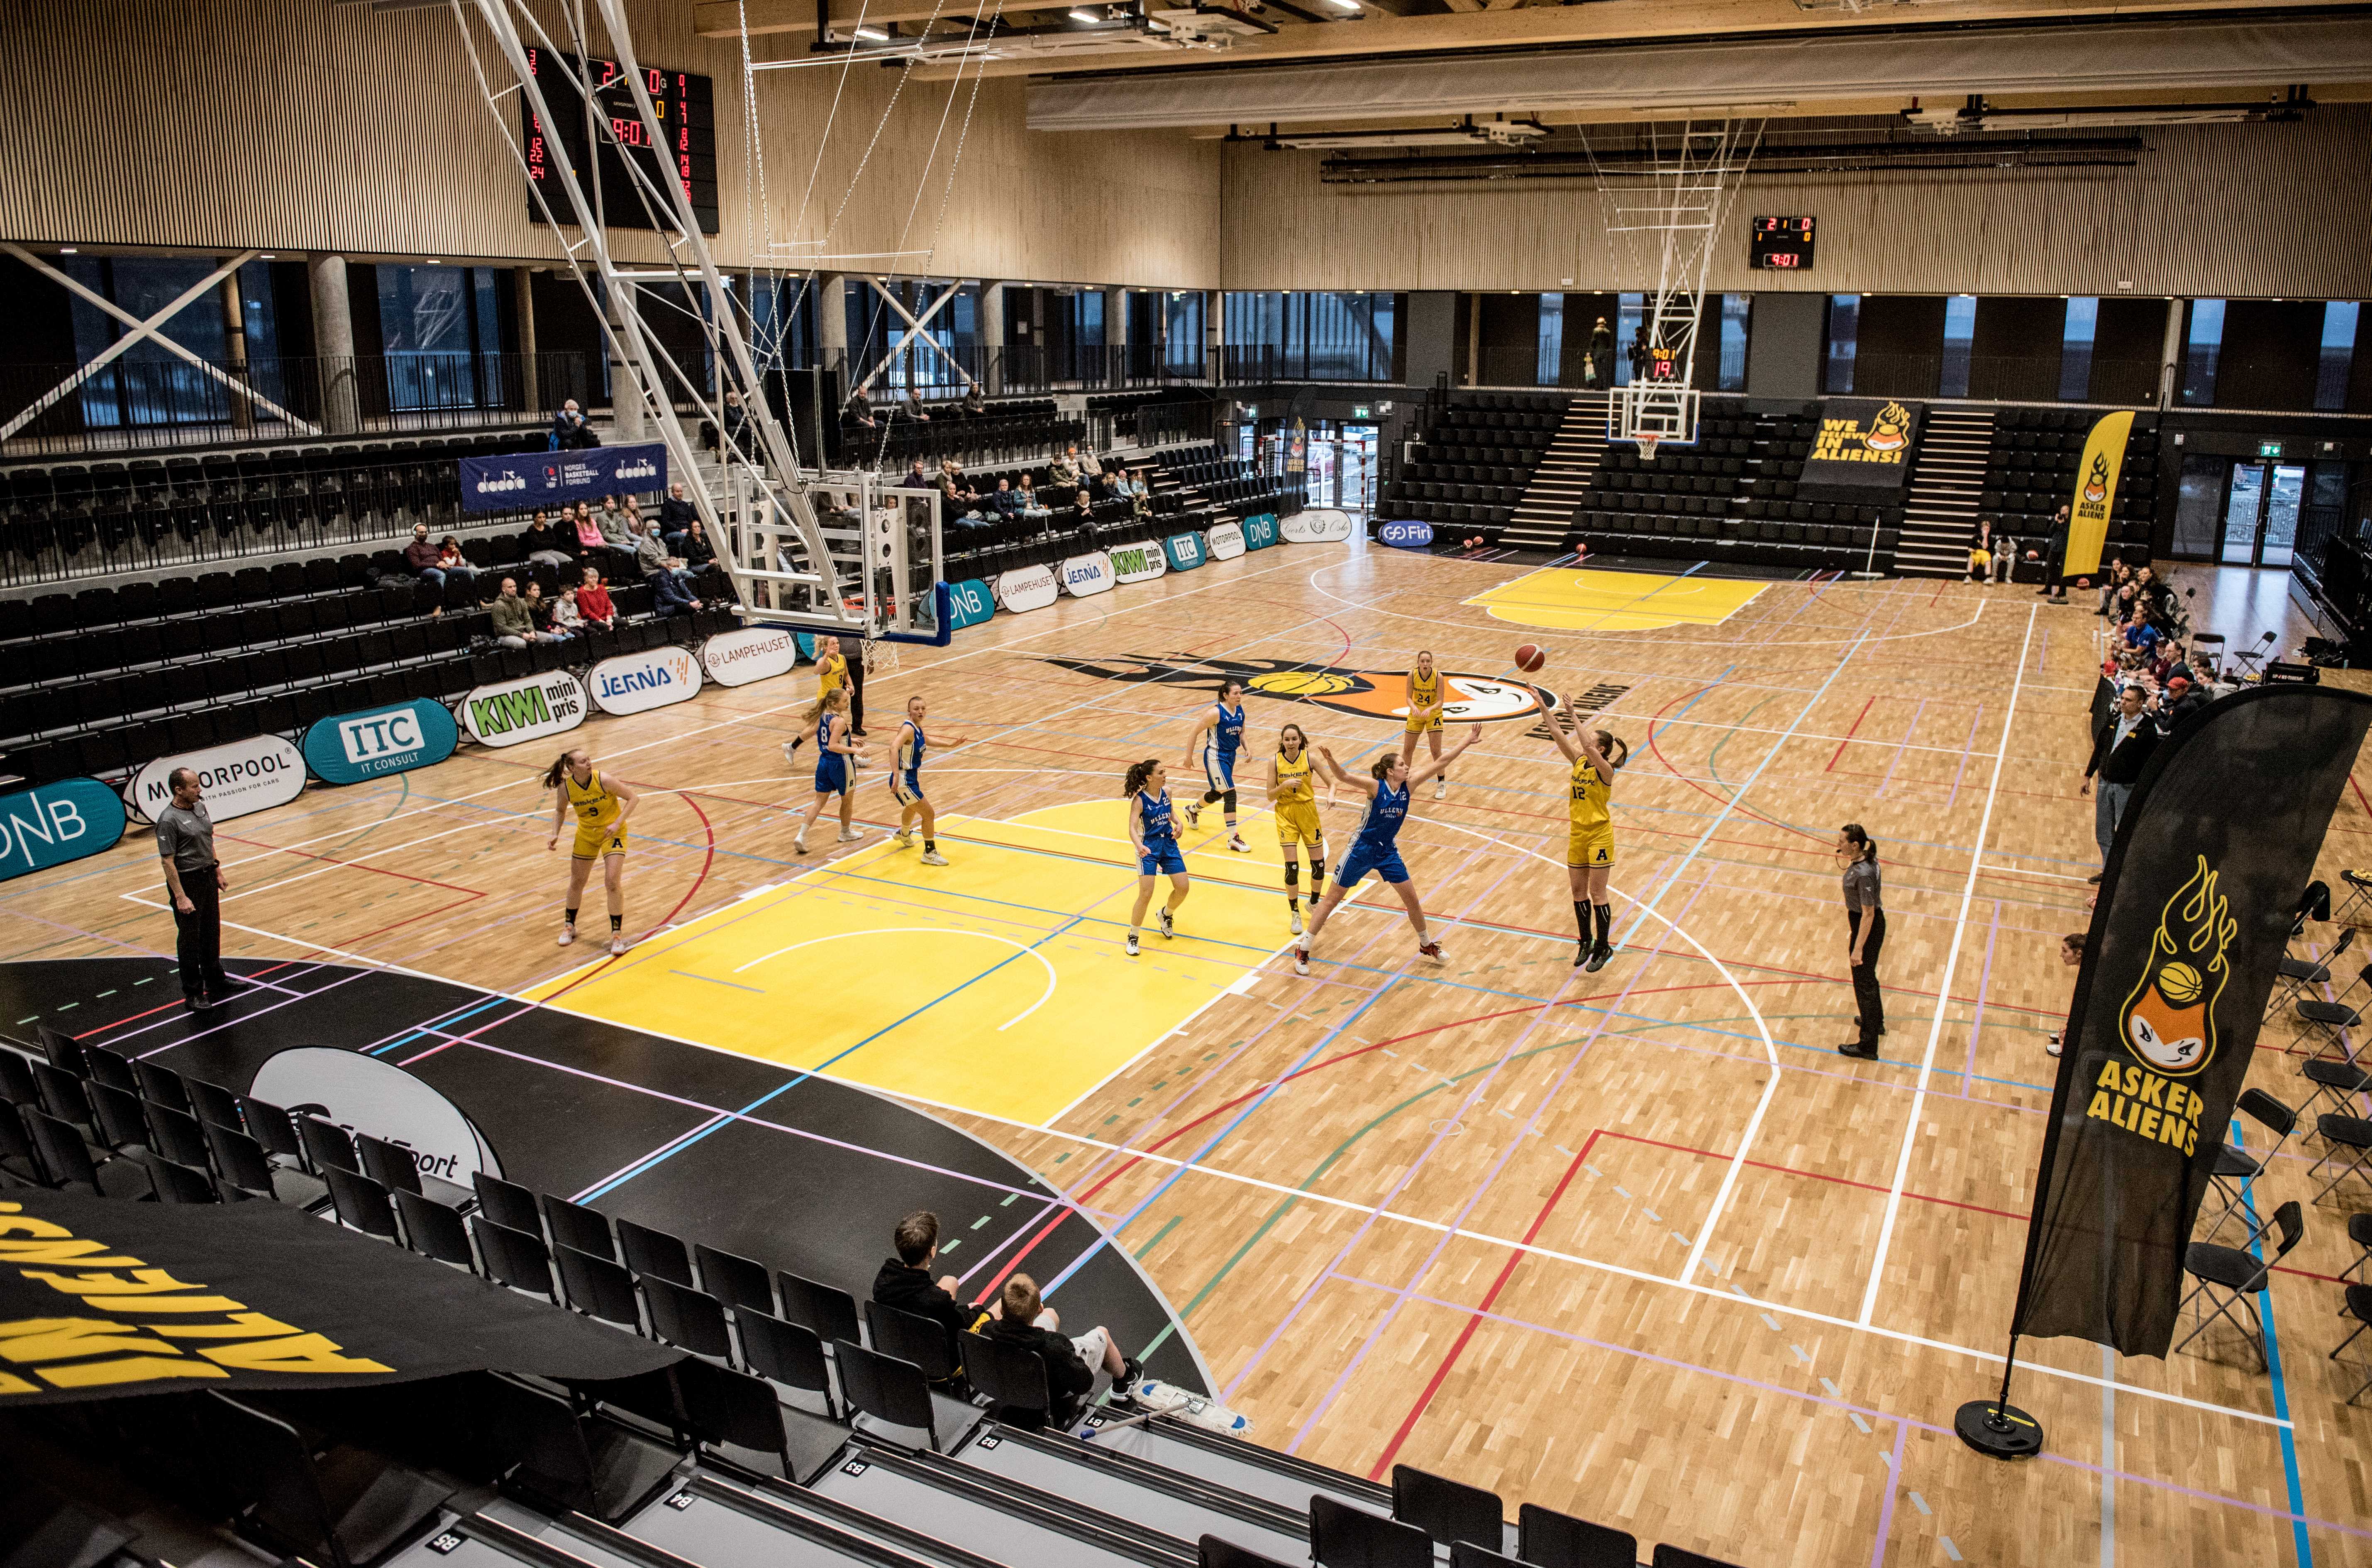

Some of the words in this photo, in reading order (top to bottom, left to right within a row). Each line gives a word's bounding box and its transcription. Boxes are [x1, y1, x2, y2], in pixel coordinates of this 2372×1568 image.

[603, 62, 613, 86] 2
[649, 69, 659, 93] 0
[679, 74, 685, 86] 0
[660, 78, 667, 89] G
[682, 87, 686, 97] 1
[656, 100, 664, 119] 0
[680, 101, 686, 112] 4
[681, 112, 687, 124] 7
[533, 137, 542, 150] 12
[530, 149, 543, 163] 22
[531, 166, 544, 179] 24
[1767, 217, 1777, 231] 2
[1783, 219, 1787, 229] 1
[1801, 217, 1811, 231] 0
[1758, 232, 1762, 241] 1
[1803, 232, 1811, 242] 0
[1772, 254, 1799, 267] 9:01
[1652, 349, 1676, 360] 9:01
[1824, 419, 1859, 432] WE
[1816, 438, 1843, 449] IN
[1811, 448, 1902, 464] ALIENS!
[565, 469, 599, 478] BASKETBALL
[616, 458, 656, 480] diadora
[477, 471, 526, 493] diadora
[2080, 502, 2106, 512] ASKER
[2078, 510, 2105, 521] ALIENS
[1249, 516, 1271, 547] DNB
[1330, 519, 1348, 532] Oslo
[1408, 525, 1431, 539] Firi
[1212, 532, 1241, 546] MOTORPOOL
[1146, 546, 1161, 559] mini
[1176, 539, 1196, 558] ITC
[1110, 548, 1149, 576] KIWI
[1149, 558, 1162, 572] pris
[1009, 575, 1055, 595] LAMPEHUSET
[721, 635, 791, 664] LAMPEHUSET
[546, 677, 576, 701] mini
[1417, 693, 1430, 704] 24
[469, 686, 551, 737] KIWI
[552, 698, 579, 722] pris
[1433, 717, 1441, 726] A
[349, 716, 415, 756] ITC
[821, 726, 828, 743] 8
[360, 761, 371, 773] IT
[375, 752, 419, 771] CONSULT
[147, 753, 291, 801] MORPOOL
[219, 787, 247, 797] PASSION
[263, 778, 280, 786] CARS
[1572, 785, 1586, 800] 12
[1399, 791, 1407, 801] 12
[612, 838, 623, 848] A
[1596, 849, 1608, 861] A
[2096, 1059, 2204, 1129] ASKER
[2086, 1090, 2198, 1157] ALIENS
[1088, 1417, 1103, 1427] B1
[981, 1436, 999, 1449] B2
[845, 1461, 866, 1475] B3
[669, 1493, 692, 1508] B4
[433, 1533, 461, 1551] B5
